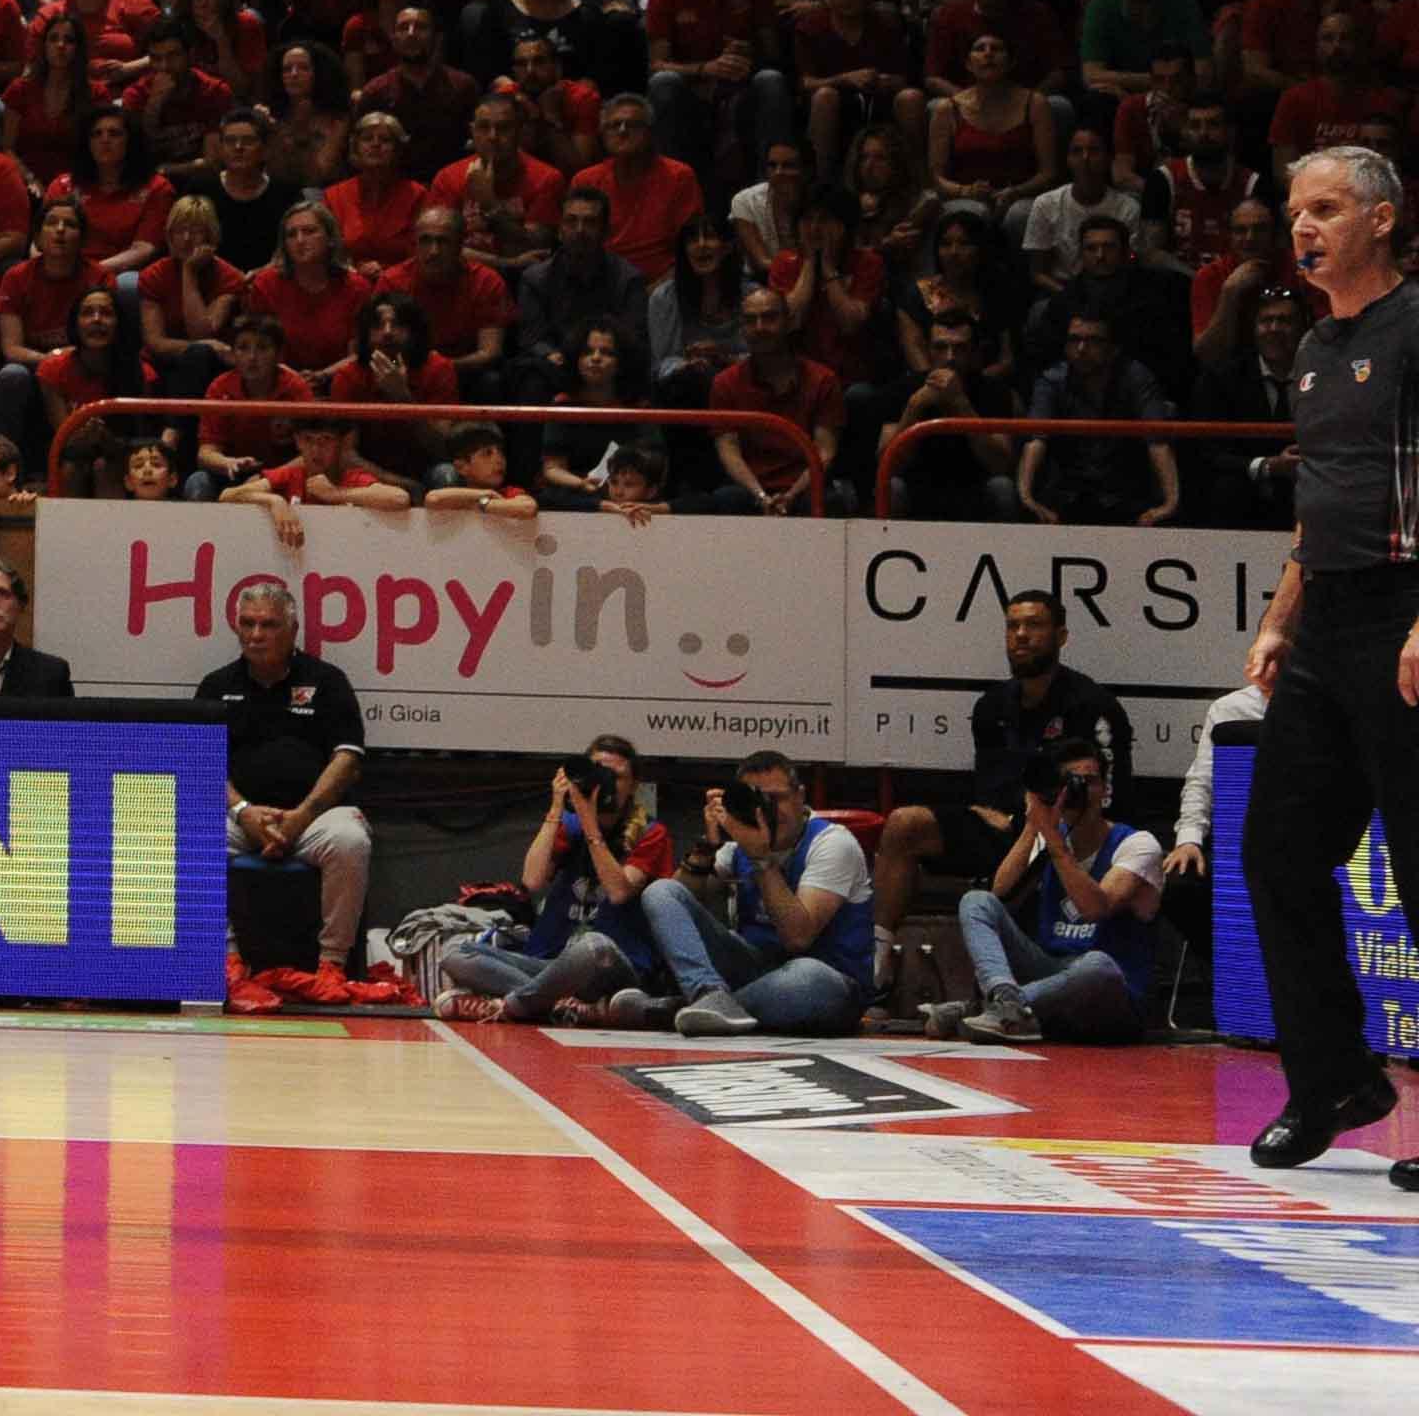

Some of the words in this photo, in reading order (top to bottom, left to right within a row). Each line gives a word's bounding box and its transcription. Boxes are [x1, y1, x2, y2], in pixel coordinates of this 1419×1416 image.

[865, 549, 1275, 632] CARSI
[366, 703, 382, 722] di
[389, 704, 441, 724] Gioia
[647, 711, 831, 738] www.happyin.it
[1382, 999, 1419, 1049] Te
